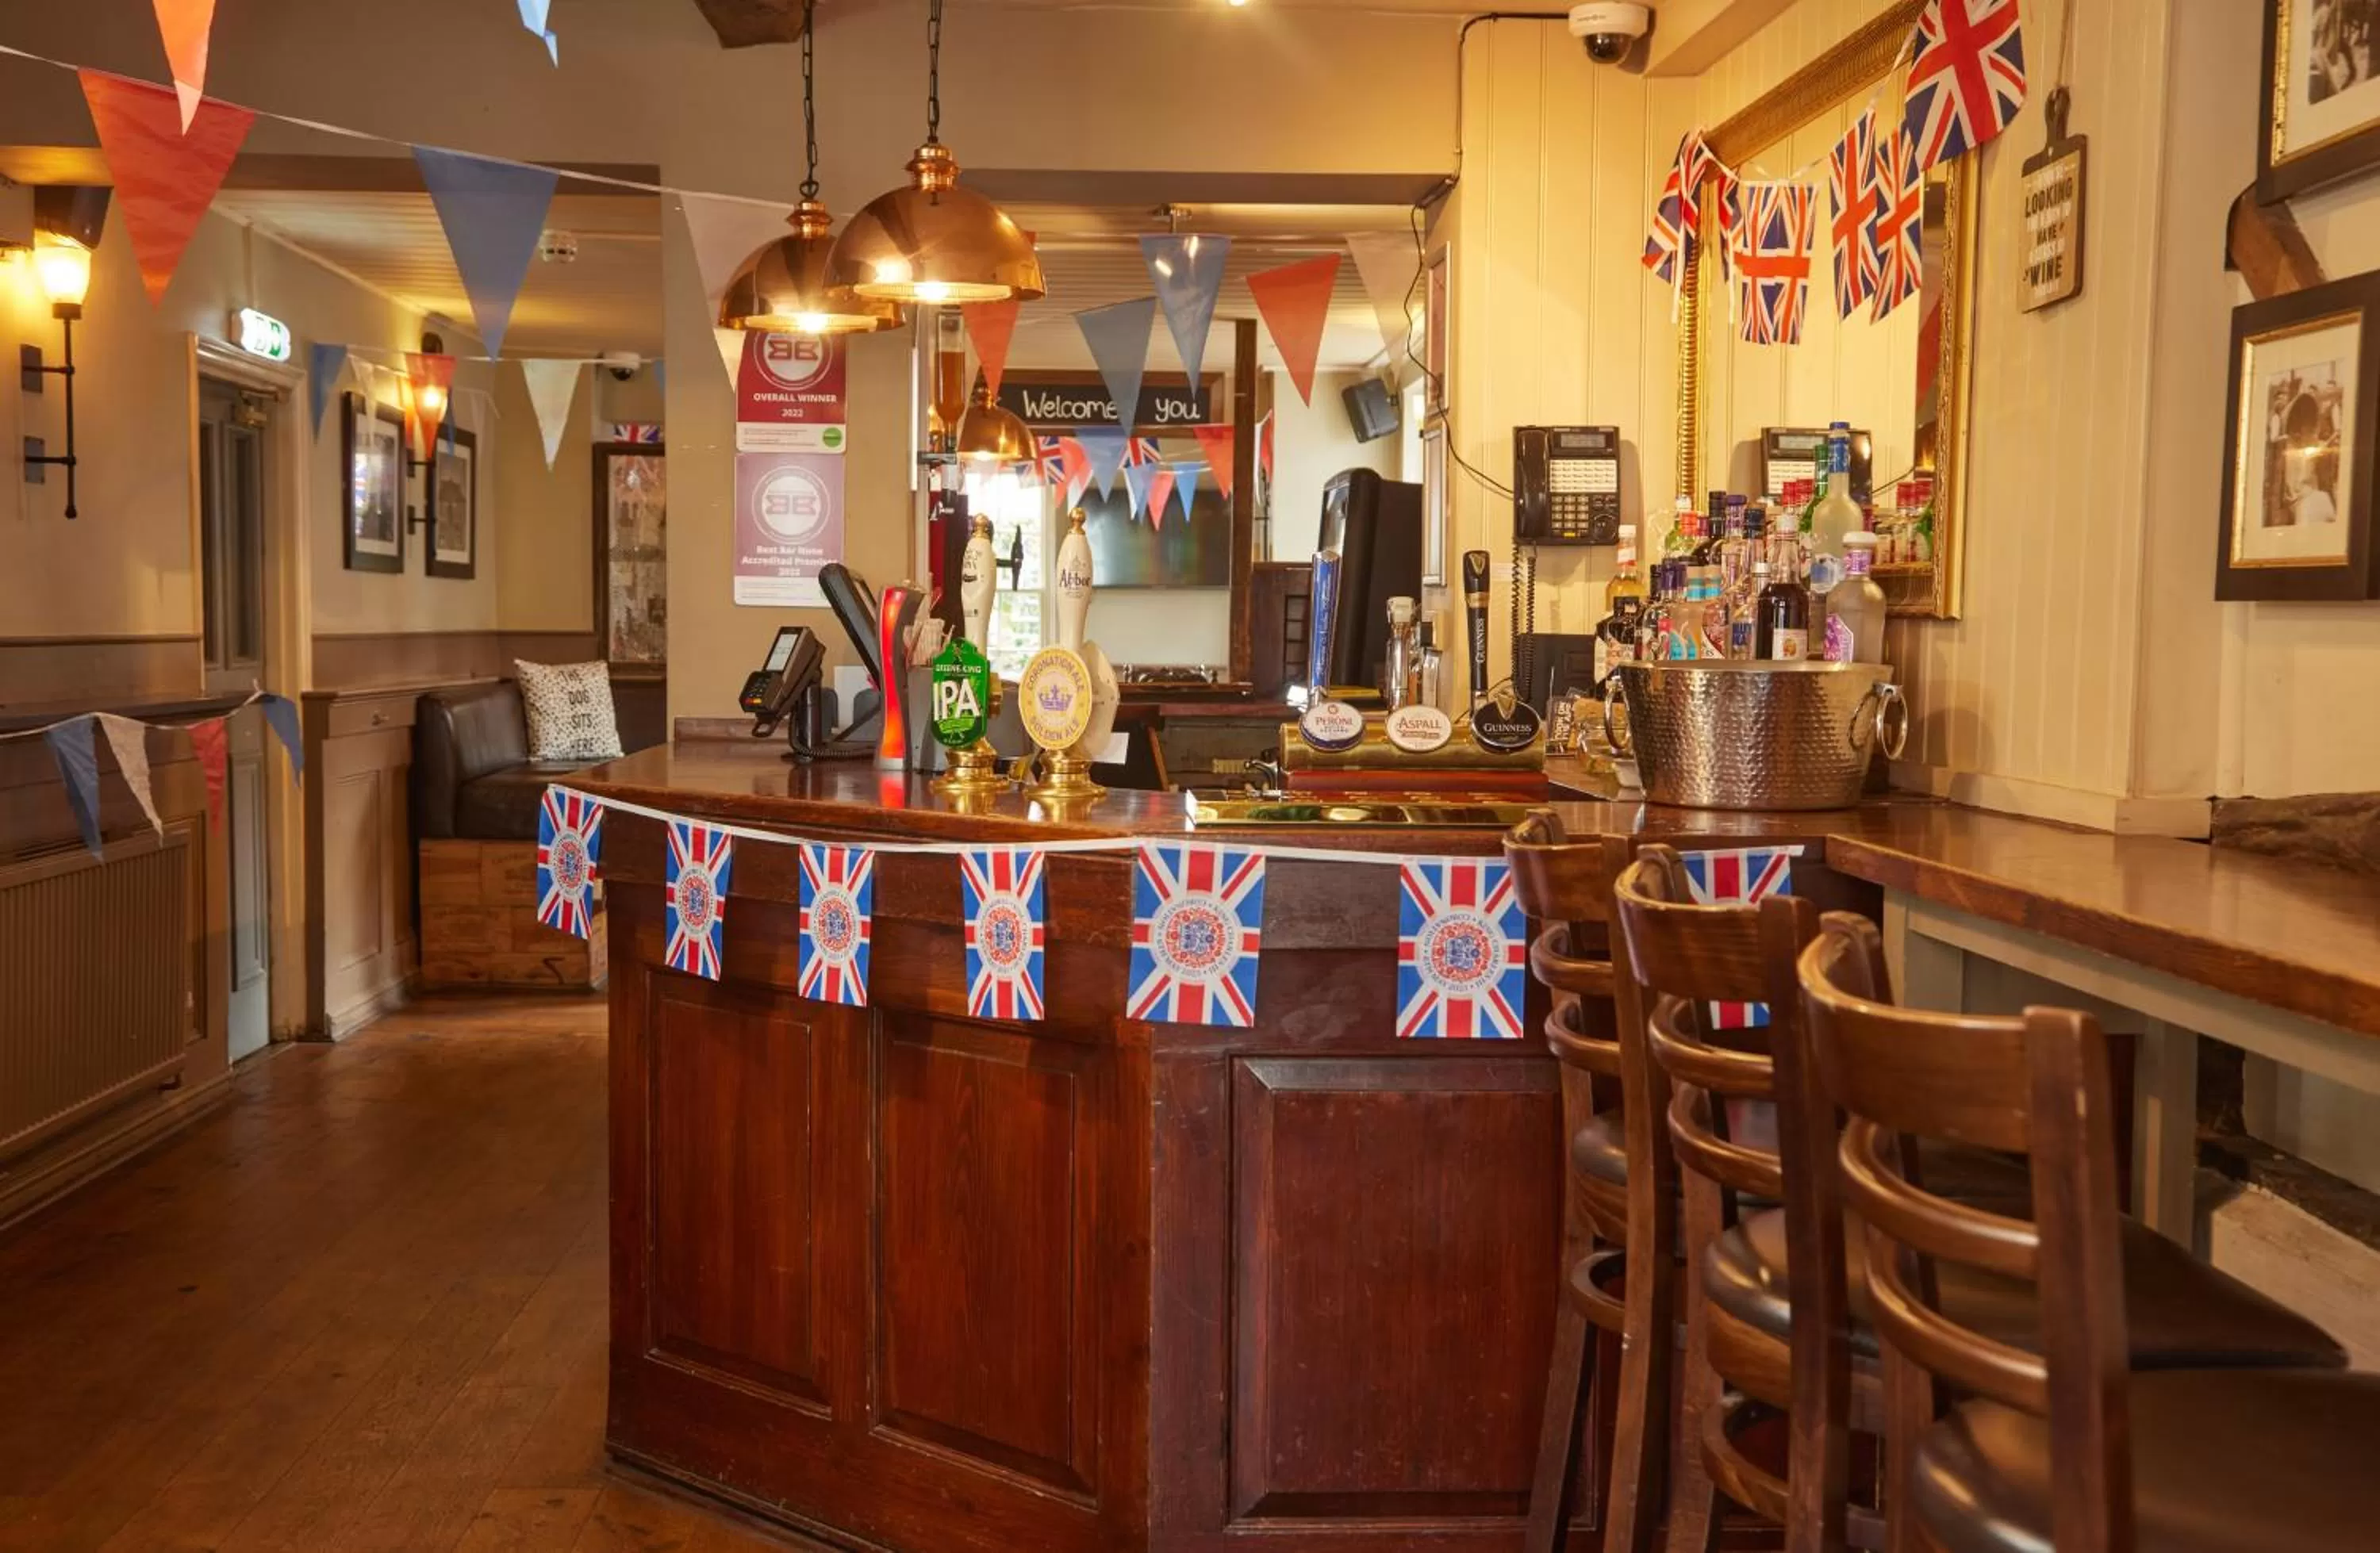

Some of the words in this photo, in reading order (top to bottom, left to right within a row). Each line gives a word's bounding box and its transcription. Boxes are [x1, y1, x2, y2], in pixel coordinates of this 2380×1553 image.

[2025, 177, 2072, 218] LOOKING
[2030, 255, 2063, 286] WINE
[753, 393, 796, 403] OVERALL
[797, 393, 838, 403] WINNER
[1023, 389, 1117, 420] Welcome
[1154, 397, 1201, 423] you
[932, 678, 981, 721] IPA
[1398, 715, 1442, 729] ASPALL
[1482, 723, 1533, 732] GUINNESS
